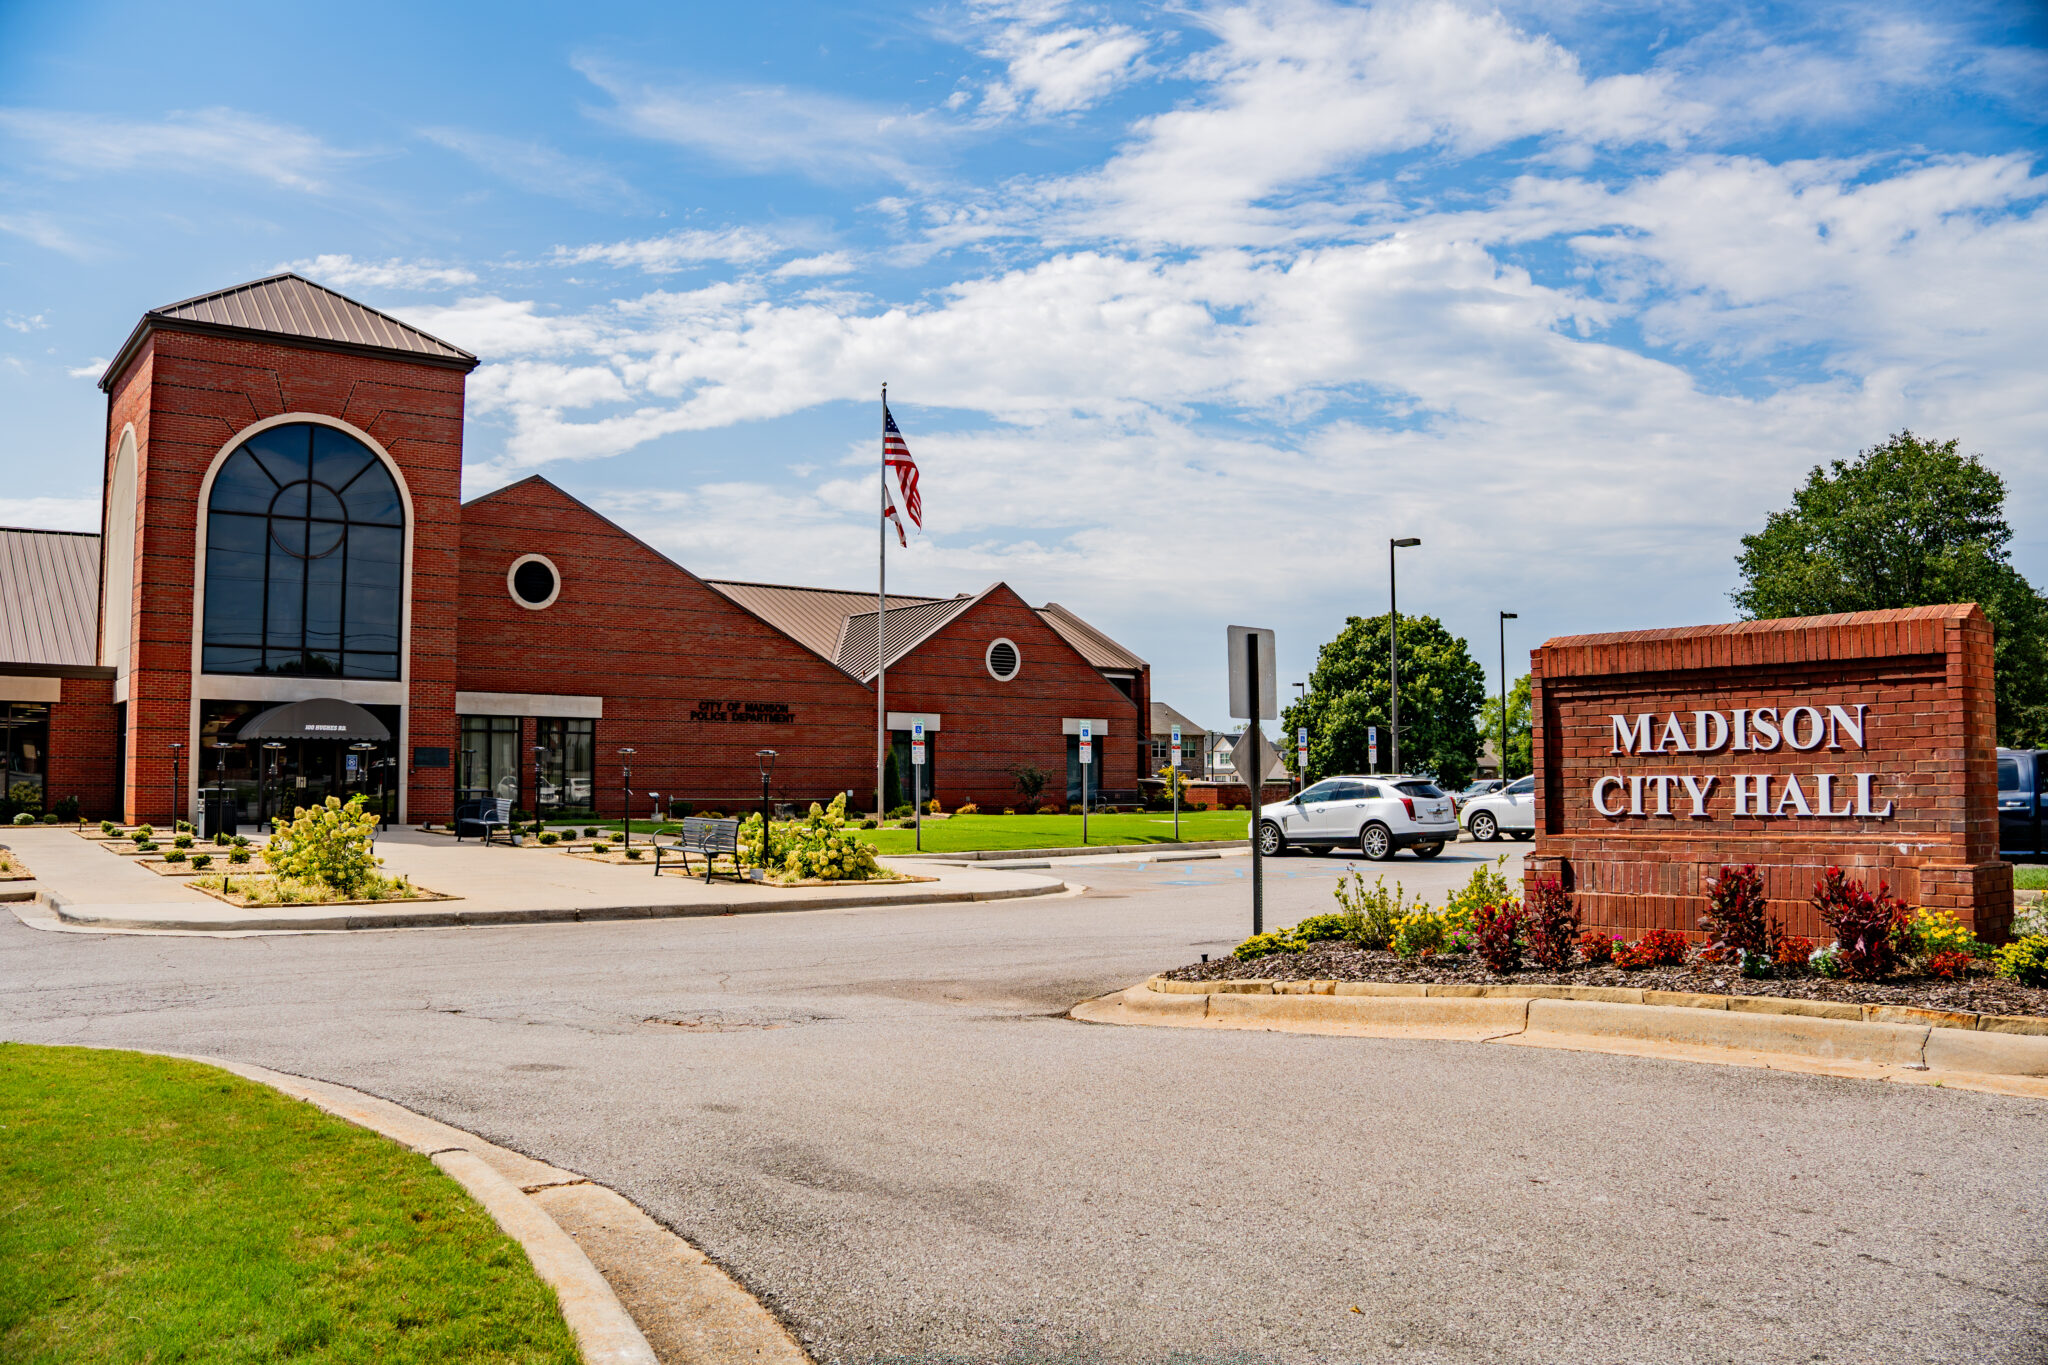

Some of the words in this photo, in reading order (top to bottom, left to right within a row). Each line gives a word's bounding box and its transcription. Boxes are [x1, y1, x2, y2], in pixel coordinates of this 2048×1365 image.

[690, 710, 727, 721] POLICE
[731, 712, 796, 723] DEPARTMENT
[698, 702, 722, 711] CITY
[727, 703, 740, 712] OF
[745, 703, 788, 713] MADISON
[1609, 704, 1868, 753] MADISON
[1592, 775, 1716, 817] CITY
[1731, 773, 1893, 817] HALL
